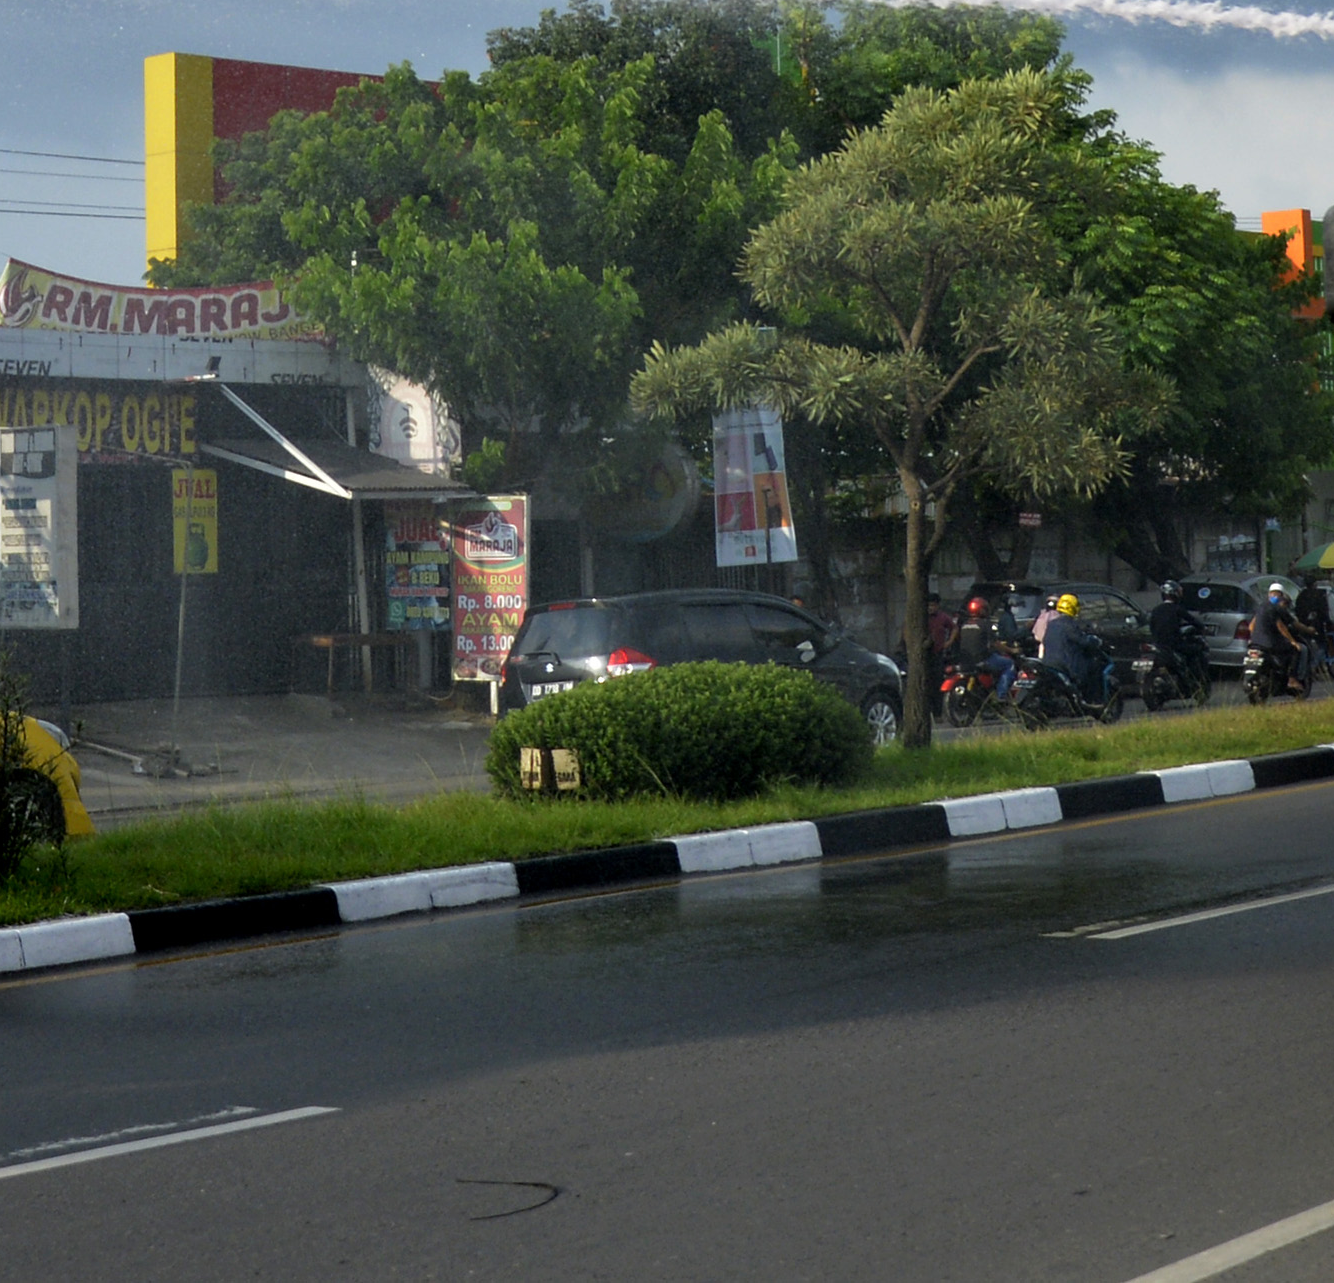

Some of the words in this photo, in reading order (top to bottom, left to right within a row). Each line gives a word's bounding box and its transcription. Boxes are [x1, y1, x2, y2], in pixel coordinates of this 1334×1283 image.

[42, 283, 304, 336] RM.MARAJ
[470, 539, 513, 553] MARAJA
[458, 574, 487, 585] IKAN
[490, 574, 523, 585] BOLU
[457, 594, 480, 612] Rp.
[484, 594, 522, 610] 8.000
[462, 612, 519, 626] AYAM
[456, 634, 477, 654] Rp.
[481, 634, 515, 651] 13.00
